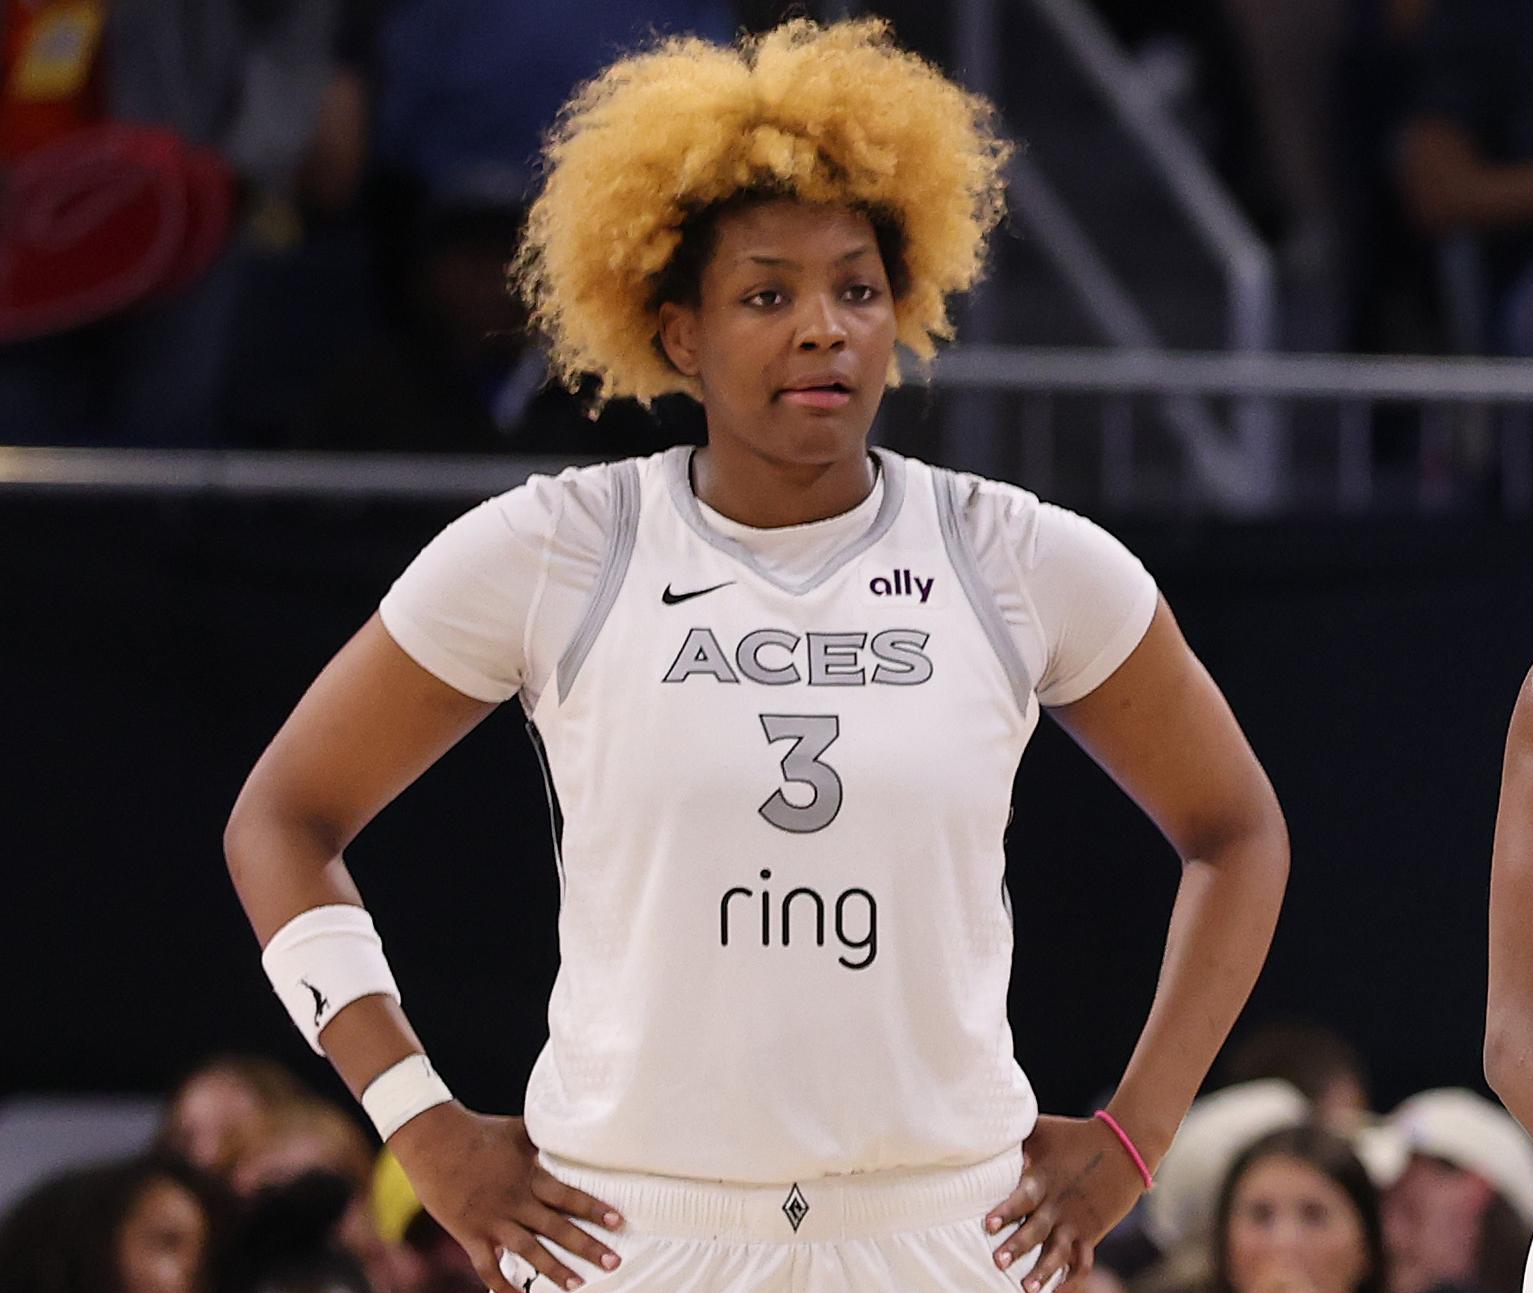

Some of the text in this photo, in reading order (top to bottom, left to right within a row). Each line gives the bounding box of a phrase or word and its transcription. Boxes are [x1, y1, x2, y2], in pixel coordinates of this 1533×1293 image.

[869, 569, 935, 603] ally
[662, 628, 933, 687] ACES
[757, 712, 844, 834] 3
[720, 868, 878, 970] ring
